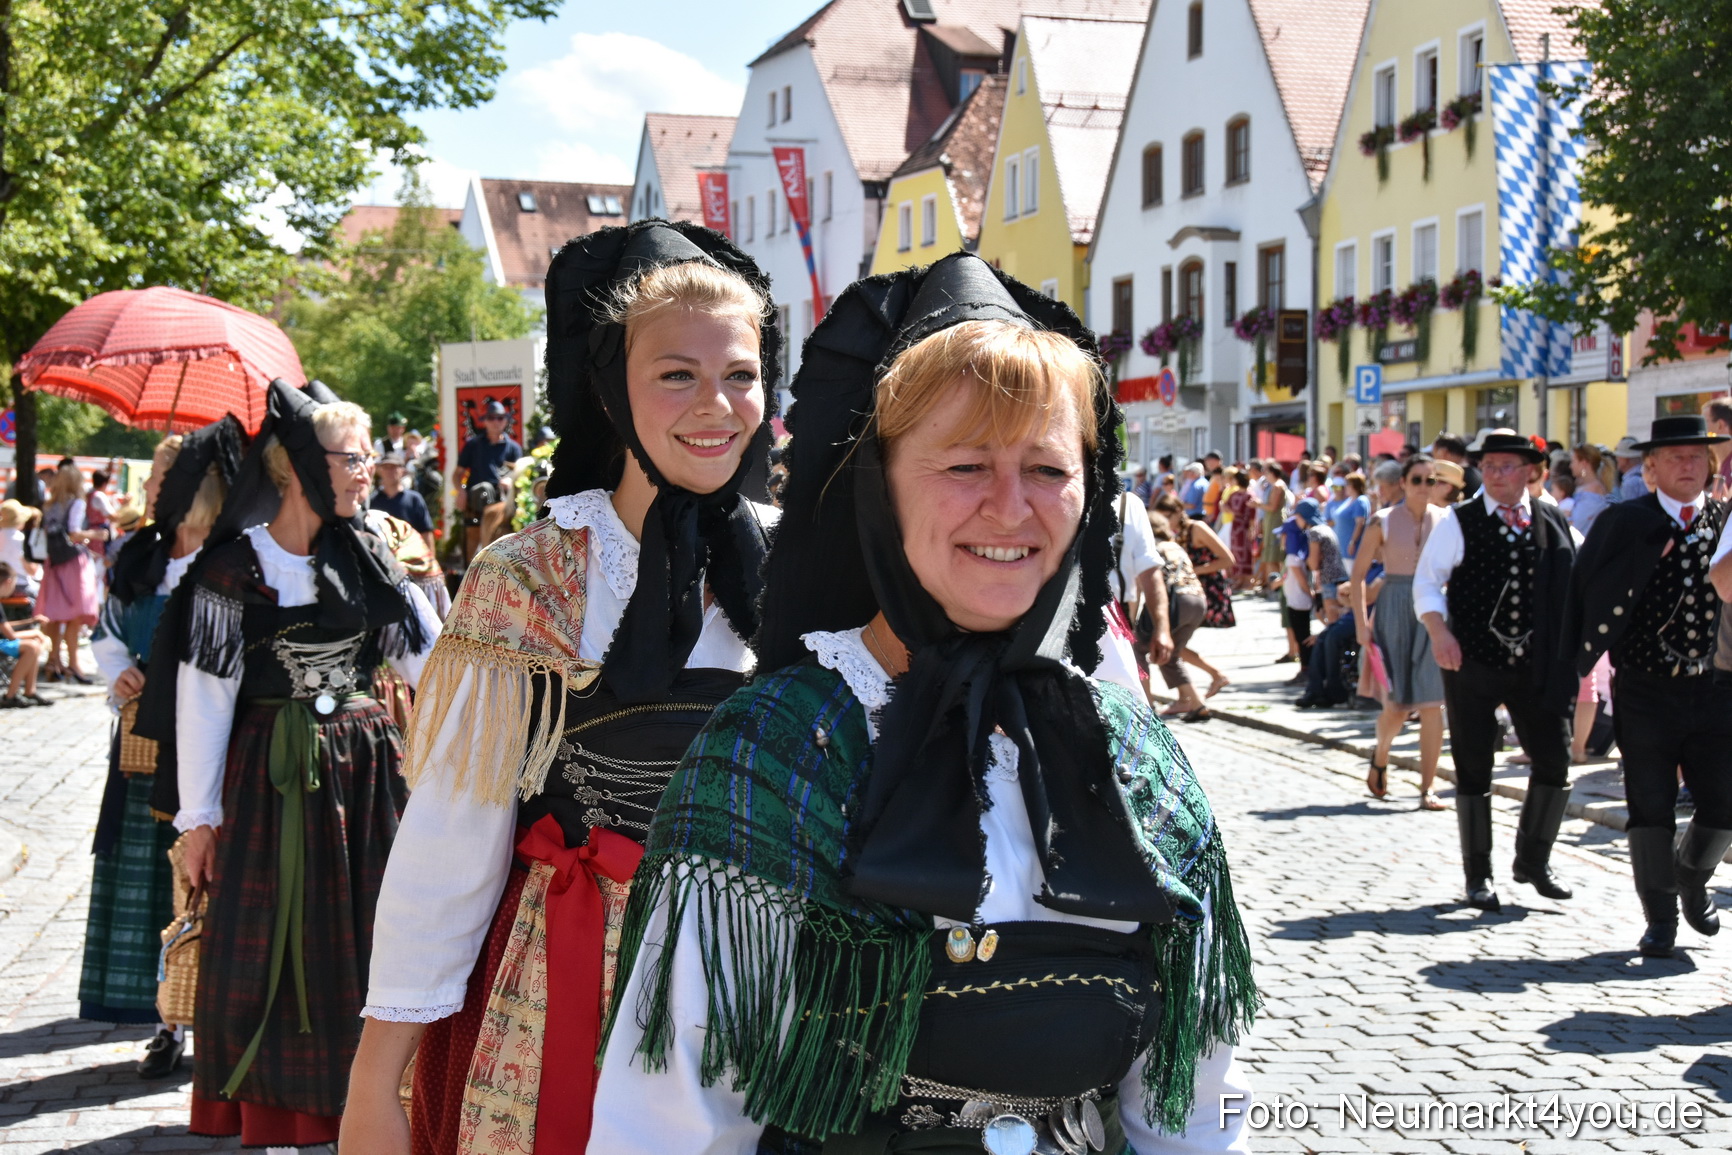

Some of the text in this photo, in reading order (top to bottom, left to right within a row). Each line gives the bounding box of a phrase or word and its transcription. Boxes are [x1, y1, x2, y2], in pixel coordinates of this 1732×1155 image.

[453, 365, 522, 383] Stadt Neumarkt
[1360, 369, 1377, 400] P
